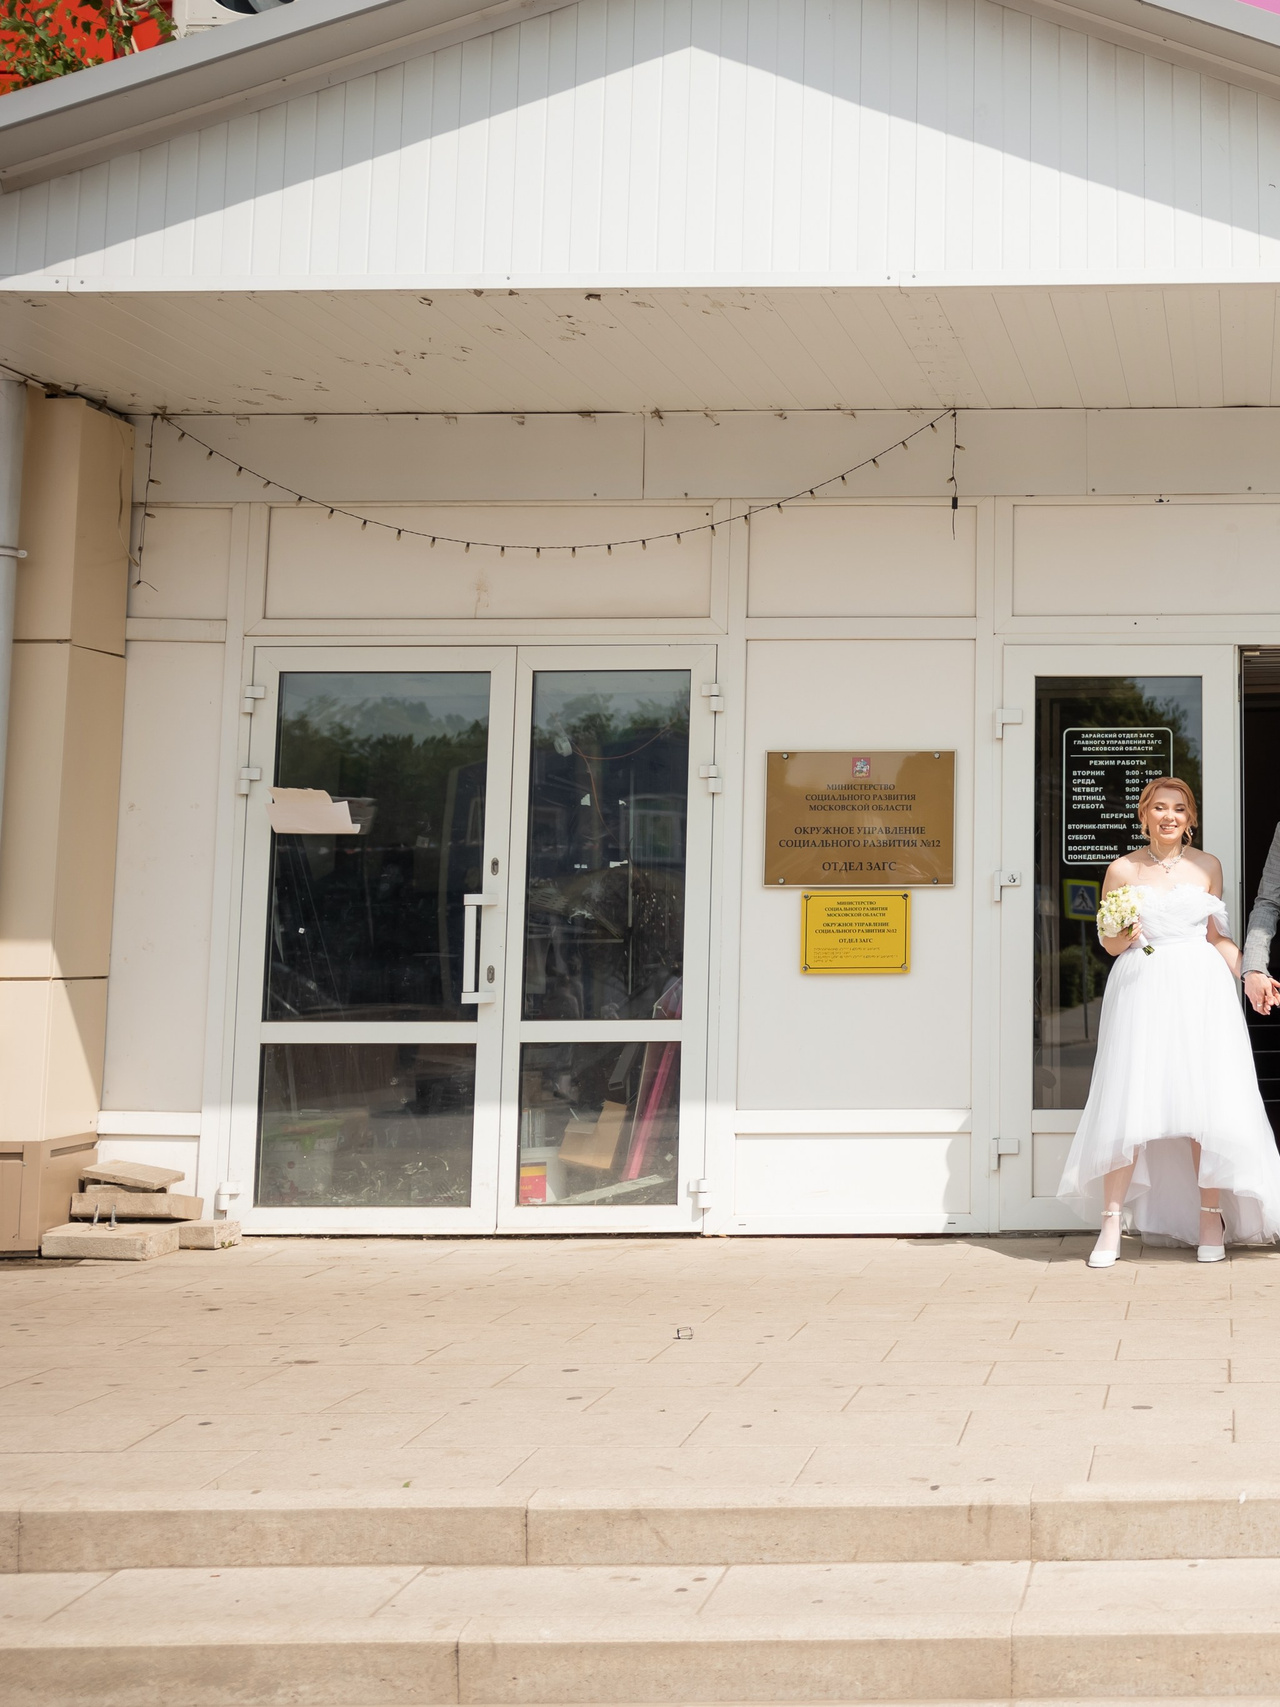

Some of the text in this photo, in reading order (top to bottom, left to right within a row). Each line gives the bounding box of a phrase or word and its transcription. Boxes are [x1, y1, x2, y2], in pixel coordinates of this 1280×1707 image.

[826, 783, 895, 791] МИНИСТЕРСТВО
[805, 794, 871, 802] СОЦИАЛЬНОГО
[808, 803, 870, 812] МОСКОВСКОЙ
[794, 826, 926, 835] ОКРУЖНОЕ УПРАВЛЕНИЕ
[778, 839, 941, 849] СОЦИАЛЬНОГО РАЗВИТИЯ №12
[822, 861, 897, 873] ОТДЕЛ ЗАГС
